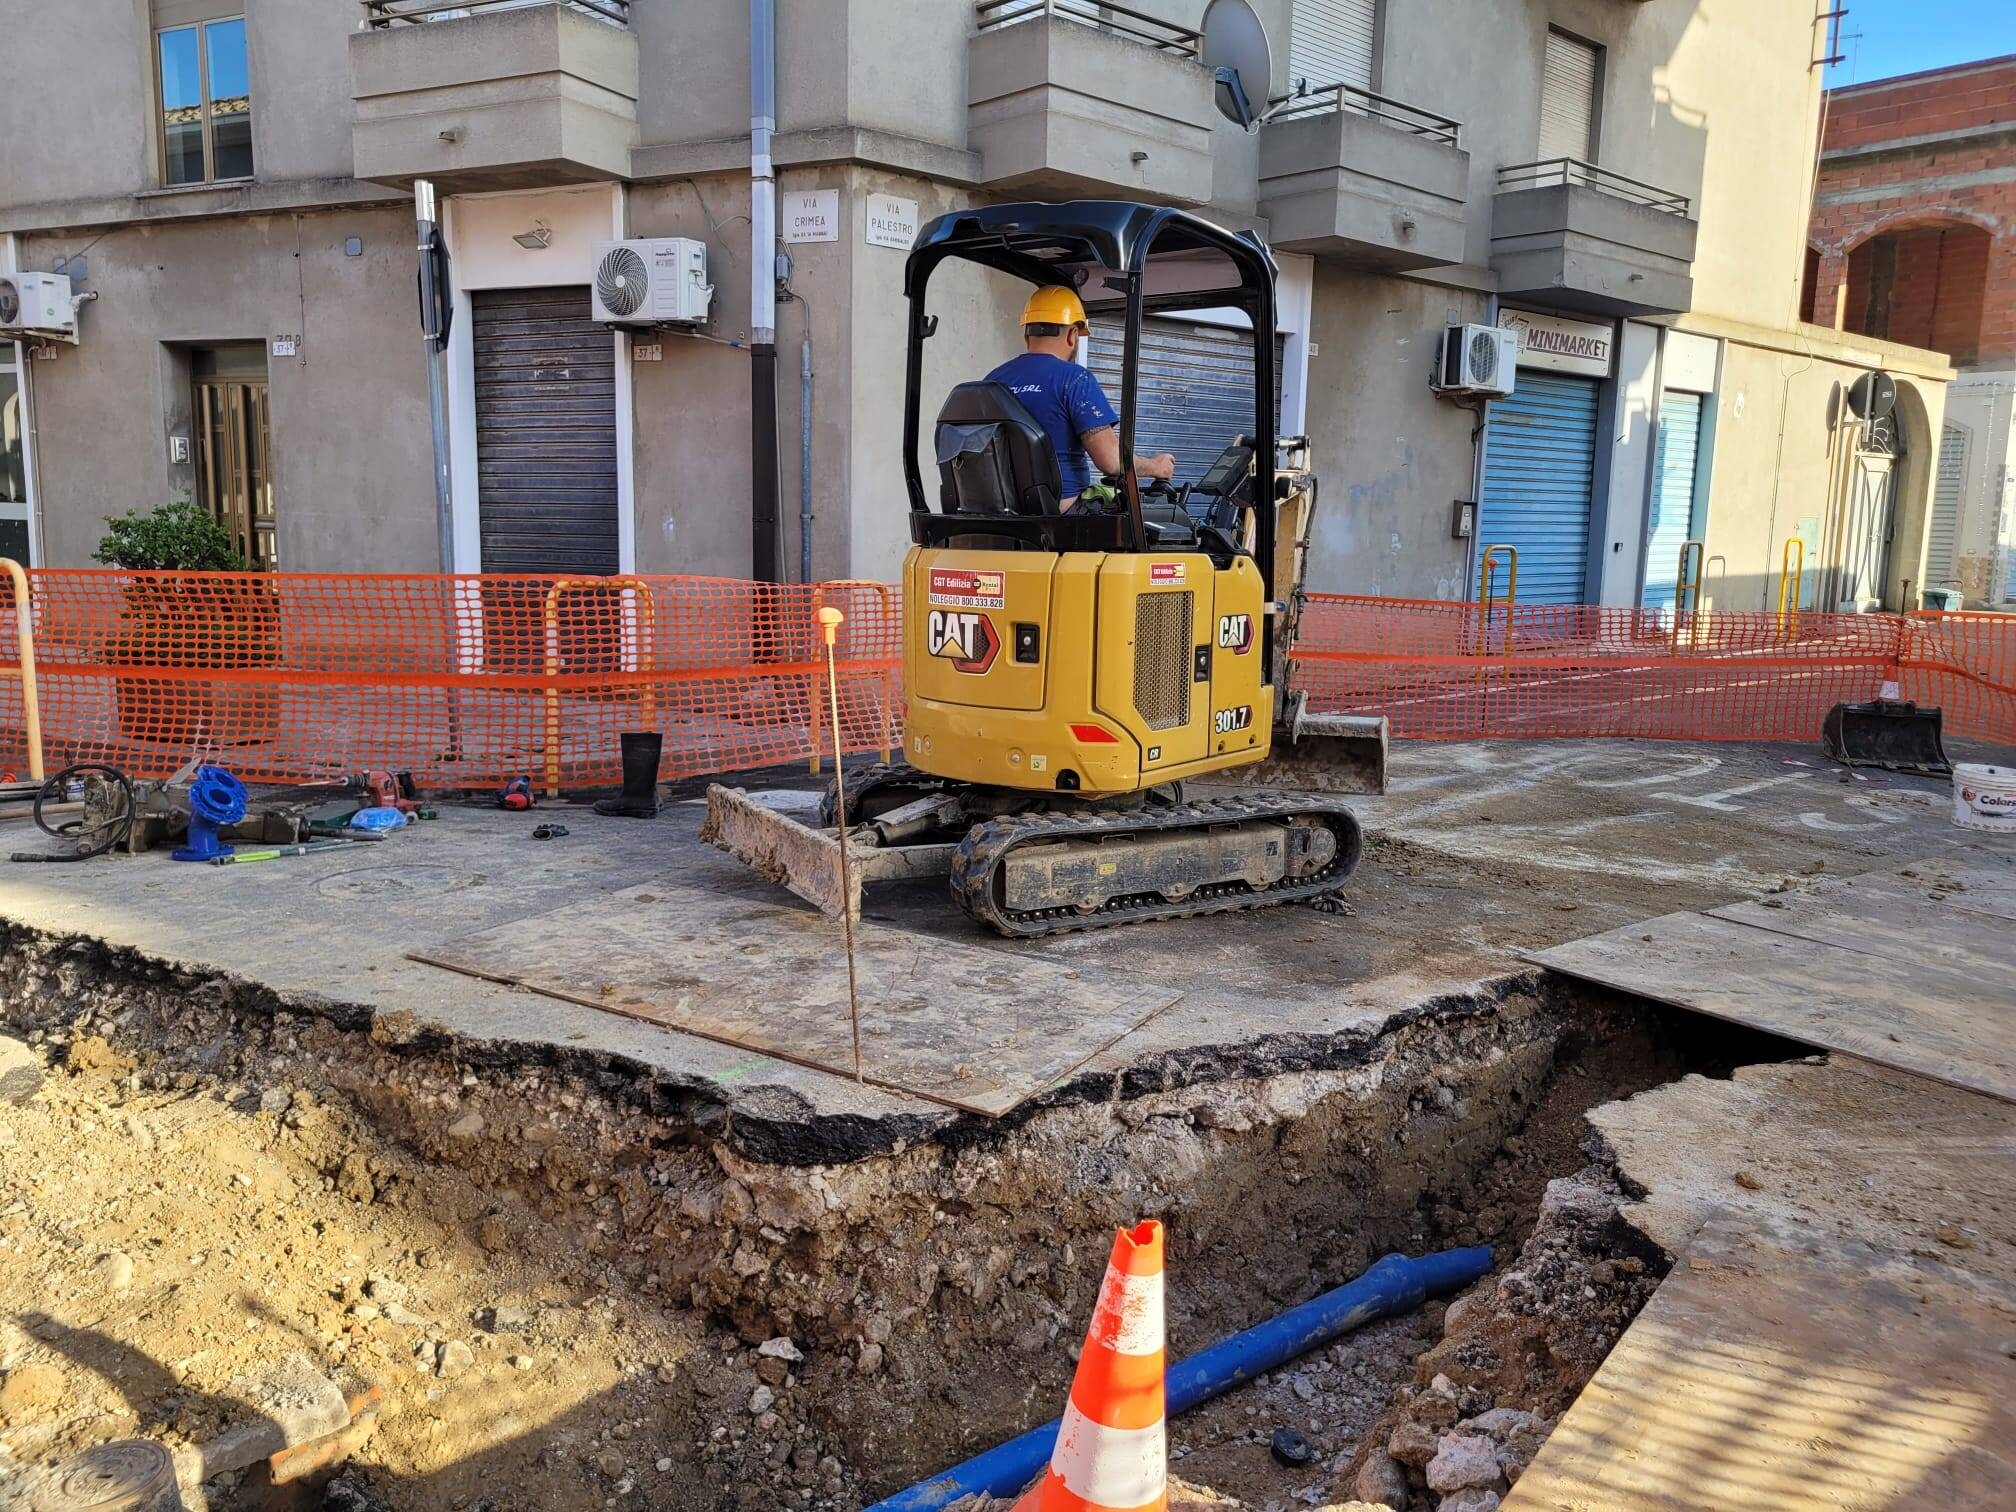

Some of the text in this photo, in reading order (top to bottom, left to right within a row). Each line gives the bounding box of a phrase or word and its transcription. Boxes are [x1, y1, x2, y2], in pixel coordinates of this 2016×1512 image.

[802, 198, 818, 209] VIA
[886, 202, 900, 215] VIA
[794, 216, 826, 228] CRIMEA
[871, 217, 913, 235] PALESTRO
[1526, 328, 1609, 358] MINIMARKET
[933, 576, 946, 587] CGT
[946, 577, 971, 589] Edilizia
[929, 594, 960, 605] NOLEGGIO
[928, 609, 980, 660] CAT
[1218, 614, 1247, 648] CAT
[1214, 706, 1248, 734] 301.7
